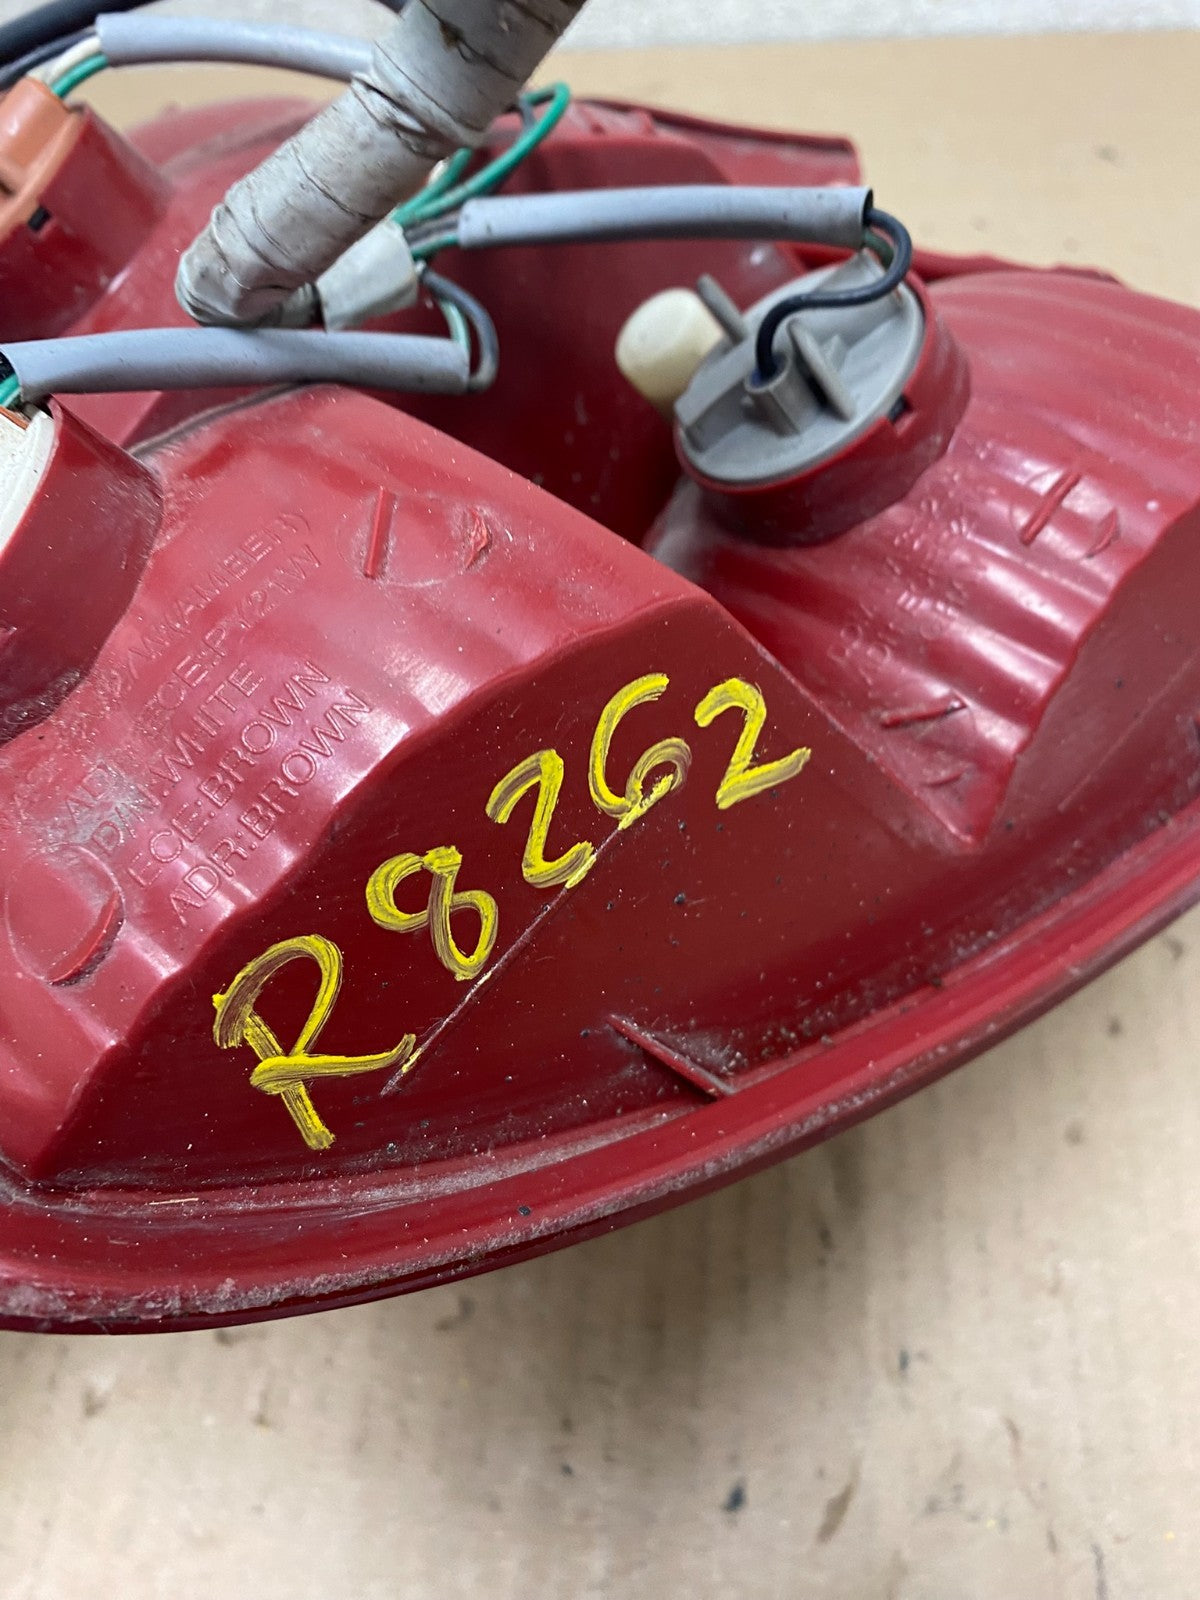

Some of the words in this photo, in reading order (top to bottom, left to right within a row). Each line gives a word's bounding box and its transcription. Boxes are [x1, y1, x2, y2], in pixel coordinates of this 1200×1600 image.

[128, 659, 331, 888] ECE:BROWN
[170, 690, 373, 926] ADR:BROWN
[212, 673, 811, 1150] R8262
